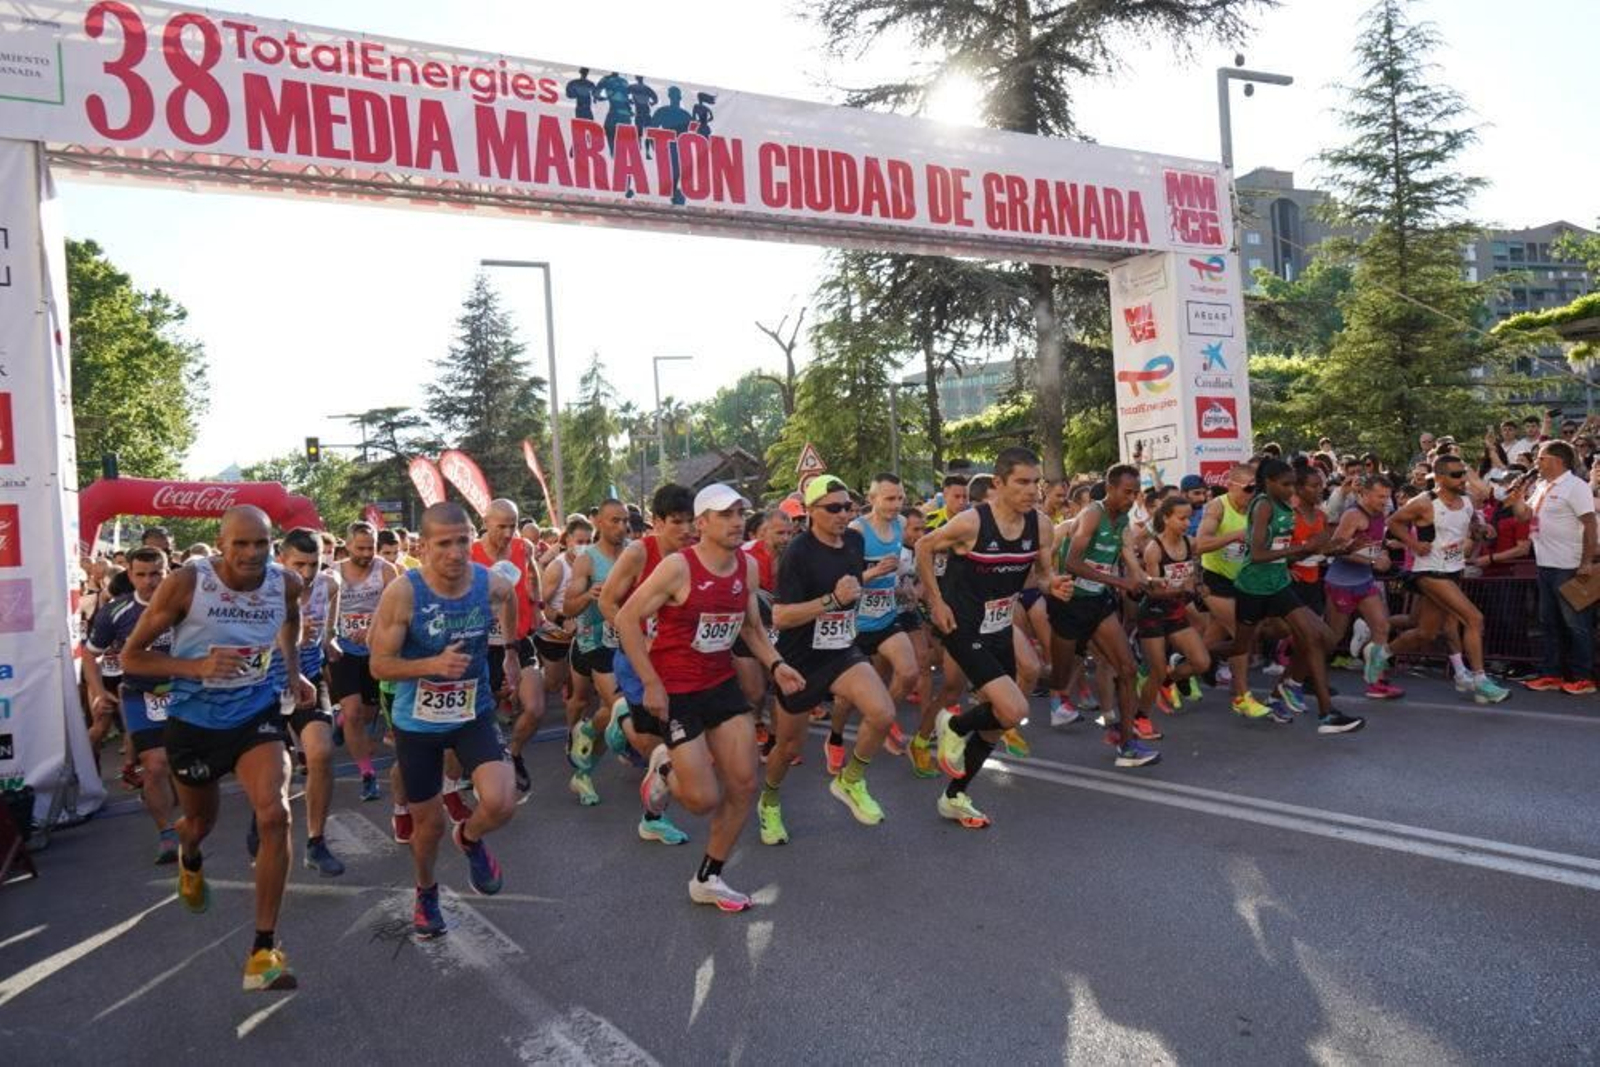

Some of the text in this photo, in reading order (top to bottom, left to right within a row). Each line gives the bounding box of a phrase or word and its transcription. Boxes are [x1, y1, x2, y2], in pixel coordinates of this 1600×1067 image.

[84, 2, 231, 145] 38
[222, 19, 559, 104] TotalEnergies
[243, 73, 1149, 244] MEDIA MARATÓN CIUDAD DE GRANADA
[1118, 399, 1178, 416] TotalEnergies
[152, 485, 239, 511] Coca-Cola
[701, 623, 735, 639] 3091
[421, 690, 468, 709] 2363
